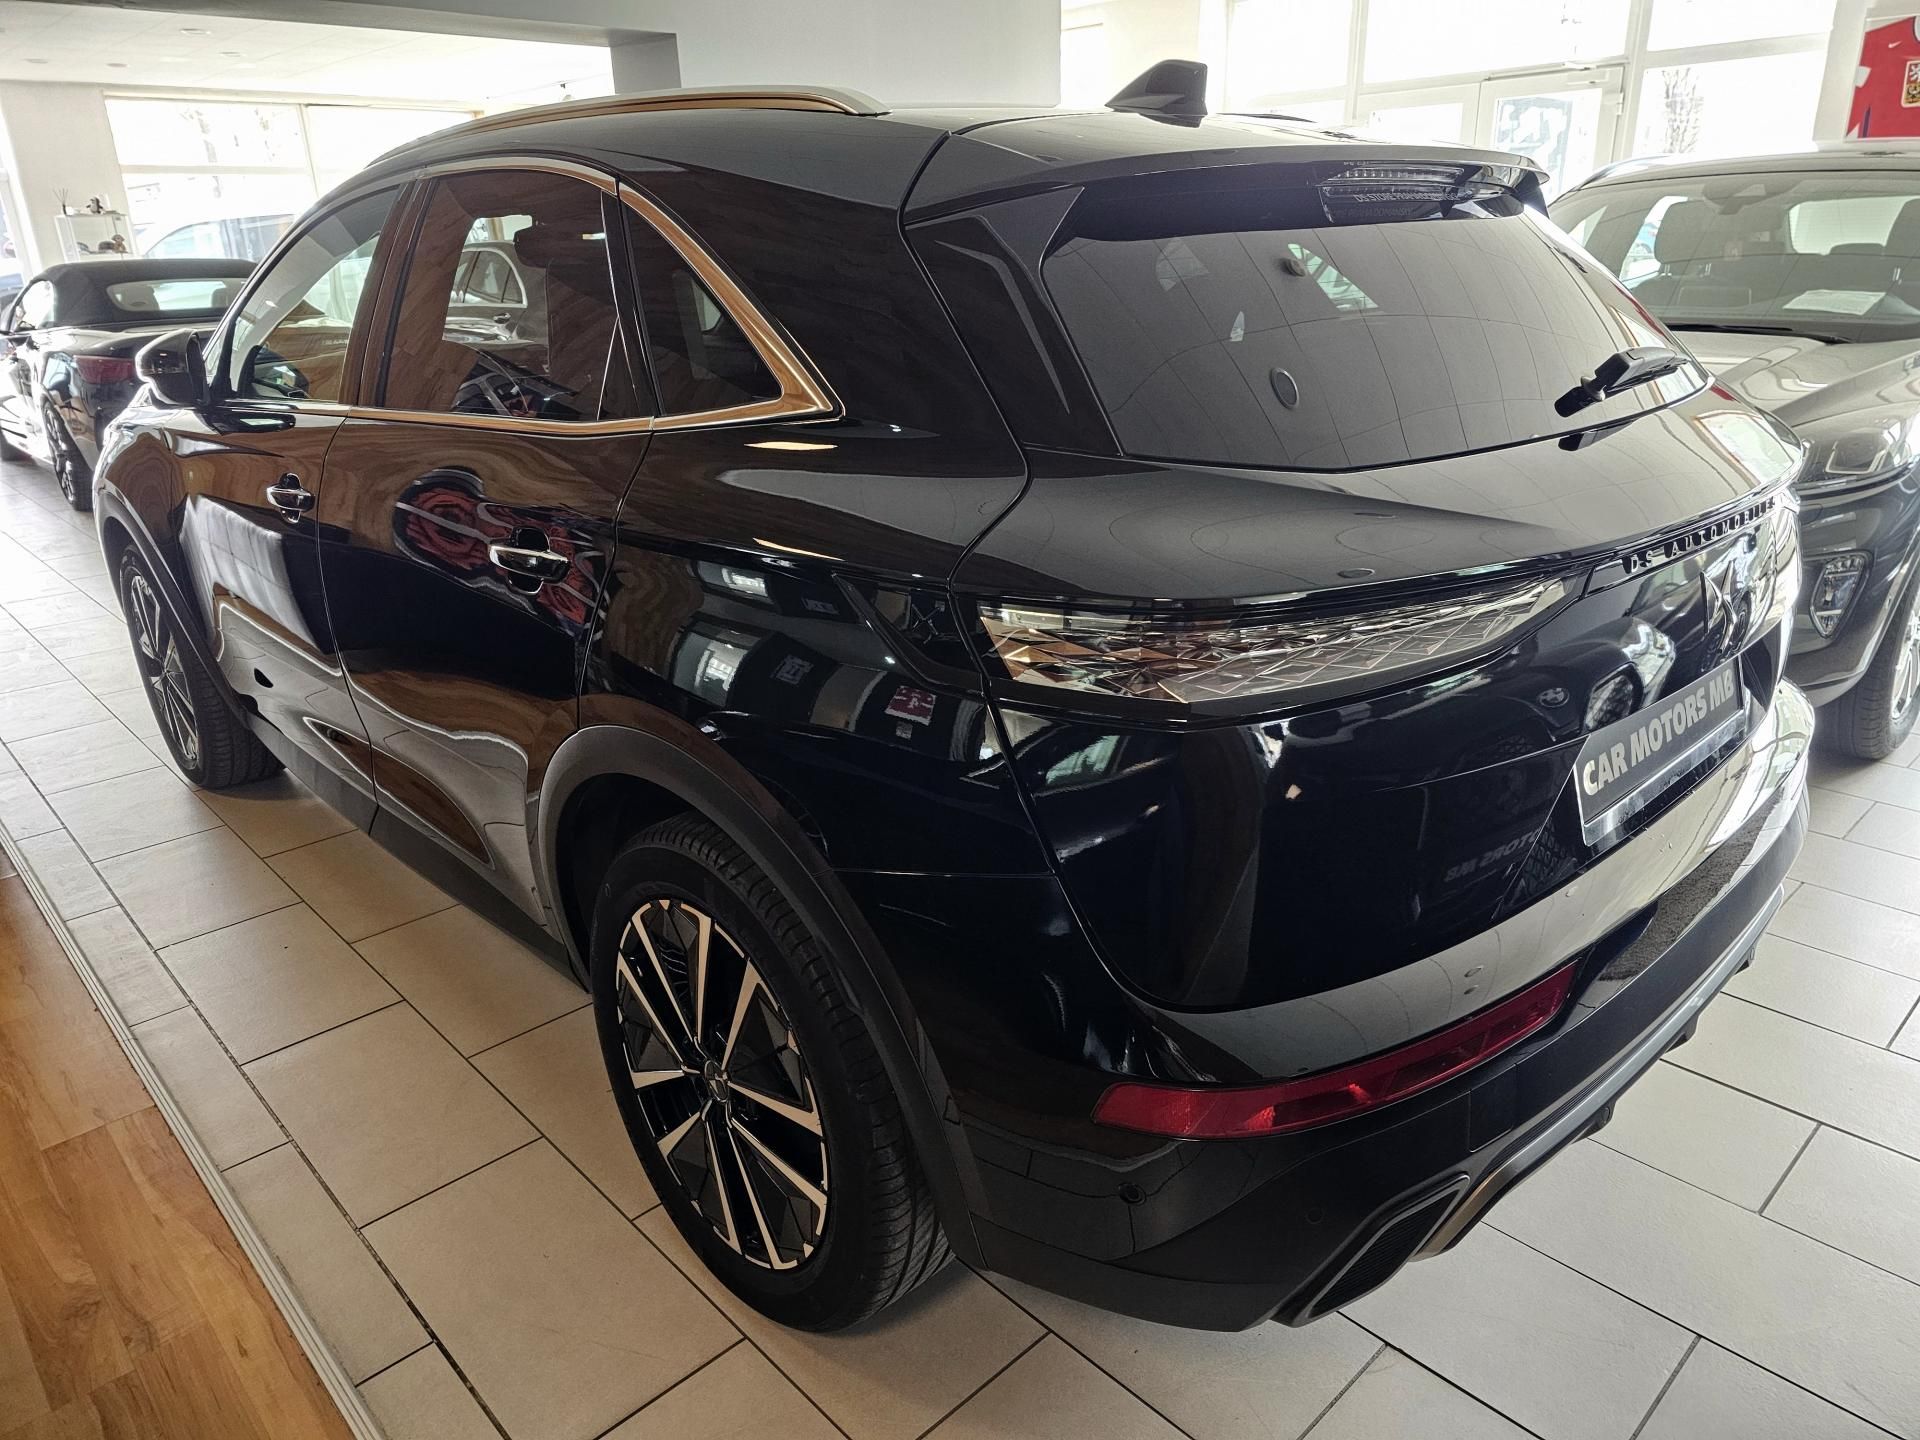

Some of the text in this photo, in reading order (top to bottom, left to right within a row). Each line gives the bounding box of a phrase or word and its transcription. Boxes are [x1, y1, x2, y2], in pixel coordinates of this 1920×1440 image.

[1631, 551, 1653, 573] DS
[1583, 669, 1735, 796] CAR MOTORS MB
